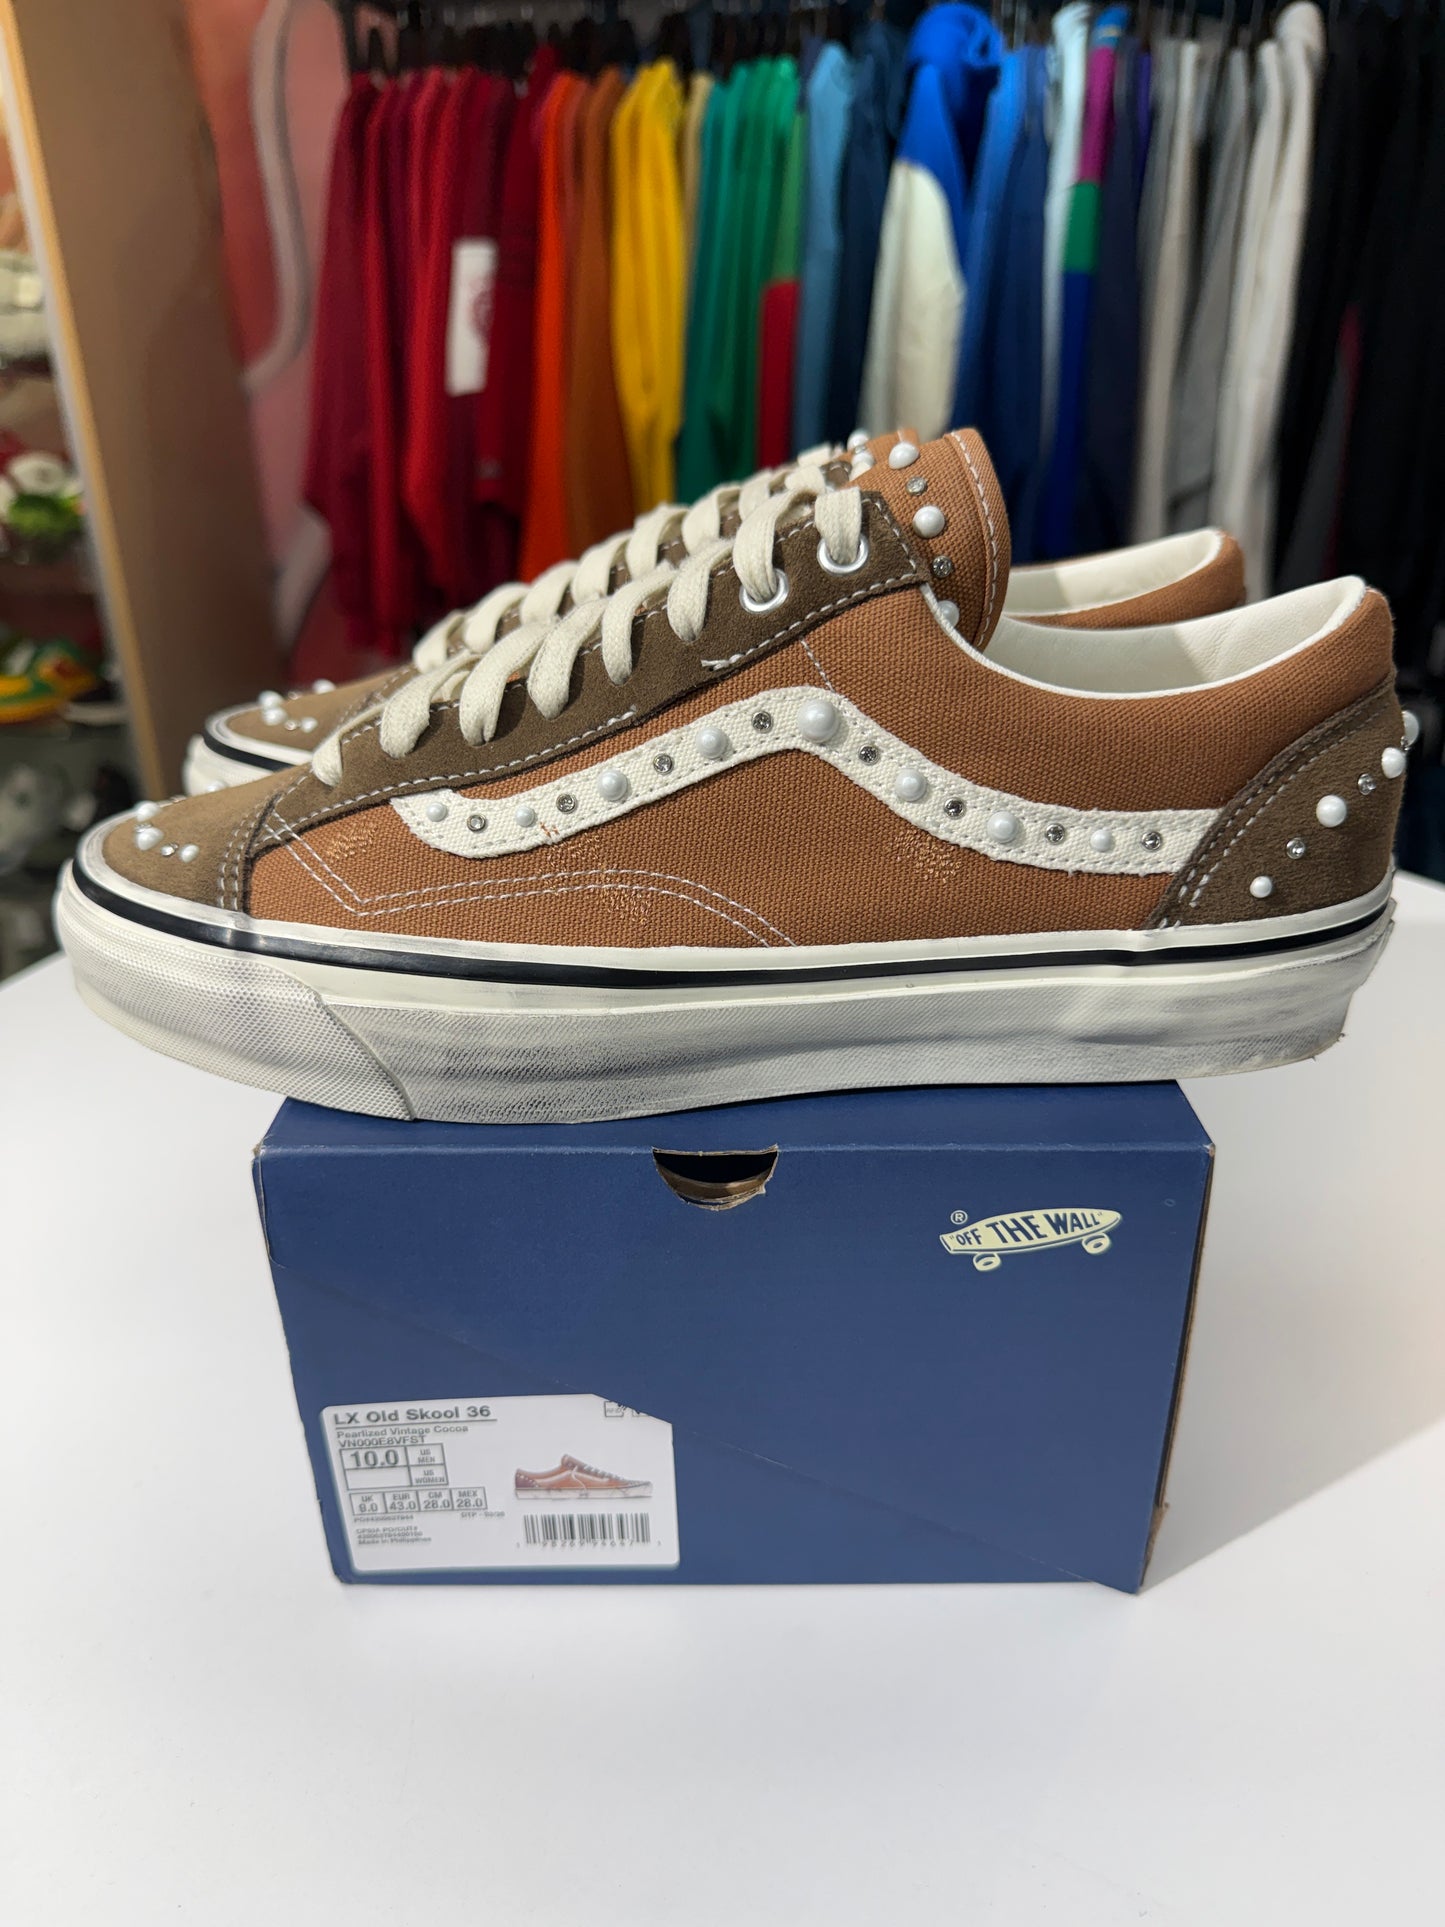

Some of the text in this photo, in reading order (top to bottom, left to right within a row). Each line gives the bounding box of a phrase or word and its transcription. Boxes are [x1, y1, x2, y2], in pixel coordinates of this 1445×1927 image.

[986, 1215, 1047, 1244] THE
[333, 1405, 491, 1425] LX Old Skool 36
[336, 1425, 469, 1439] Pearlized Vintage Cocoa
[350, 1449, 399, 1468] 10.0
[458, 1490, 478, 1498] MEX
[389, 1501, 416, 1511] 43.0
[423, 1499, 450, 1510] 28.0
[455, 1498, 483, 1508] 28.0
